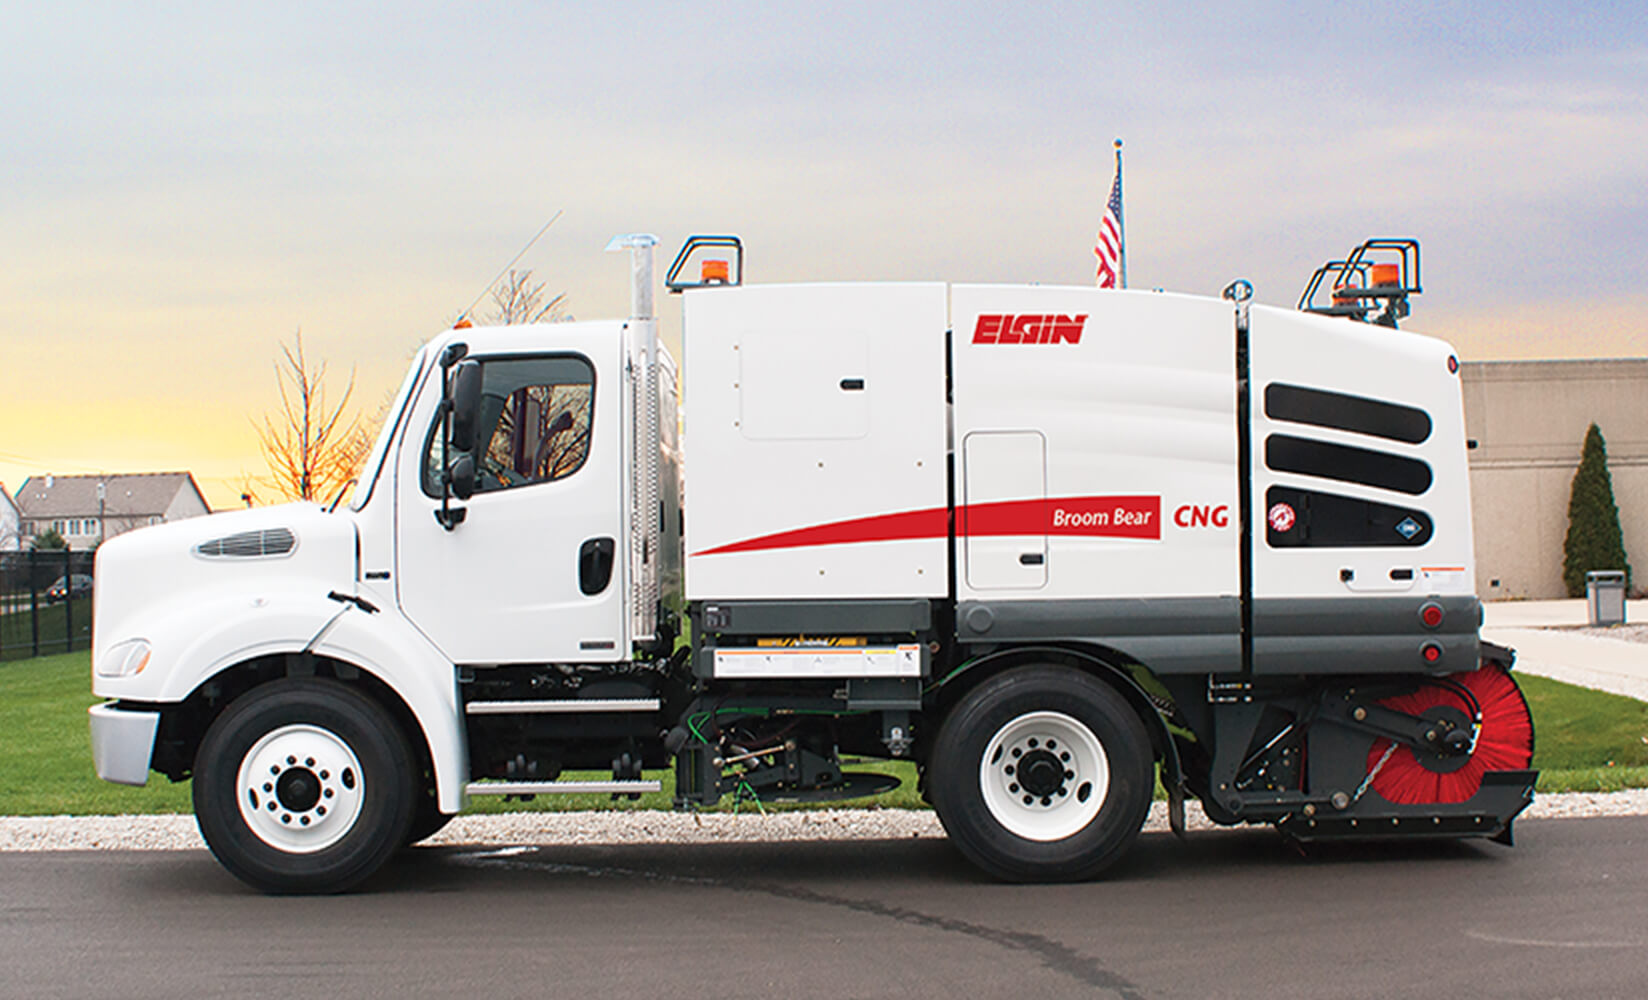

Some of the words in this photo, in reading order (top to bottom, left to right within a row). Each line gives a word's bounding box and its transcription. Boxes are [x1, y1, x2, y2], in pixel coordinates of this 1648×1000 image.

[972, 314, 1088, 345] ELGIN
[1053, 508, 1109, 527] Broom
[1113, 507, 1152, 526] Bear
[1173, 505, 1229, 528] CNG
